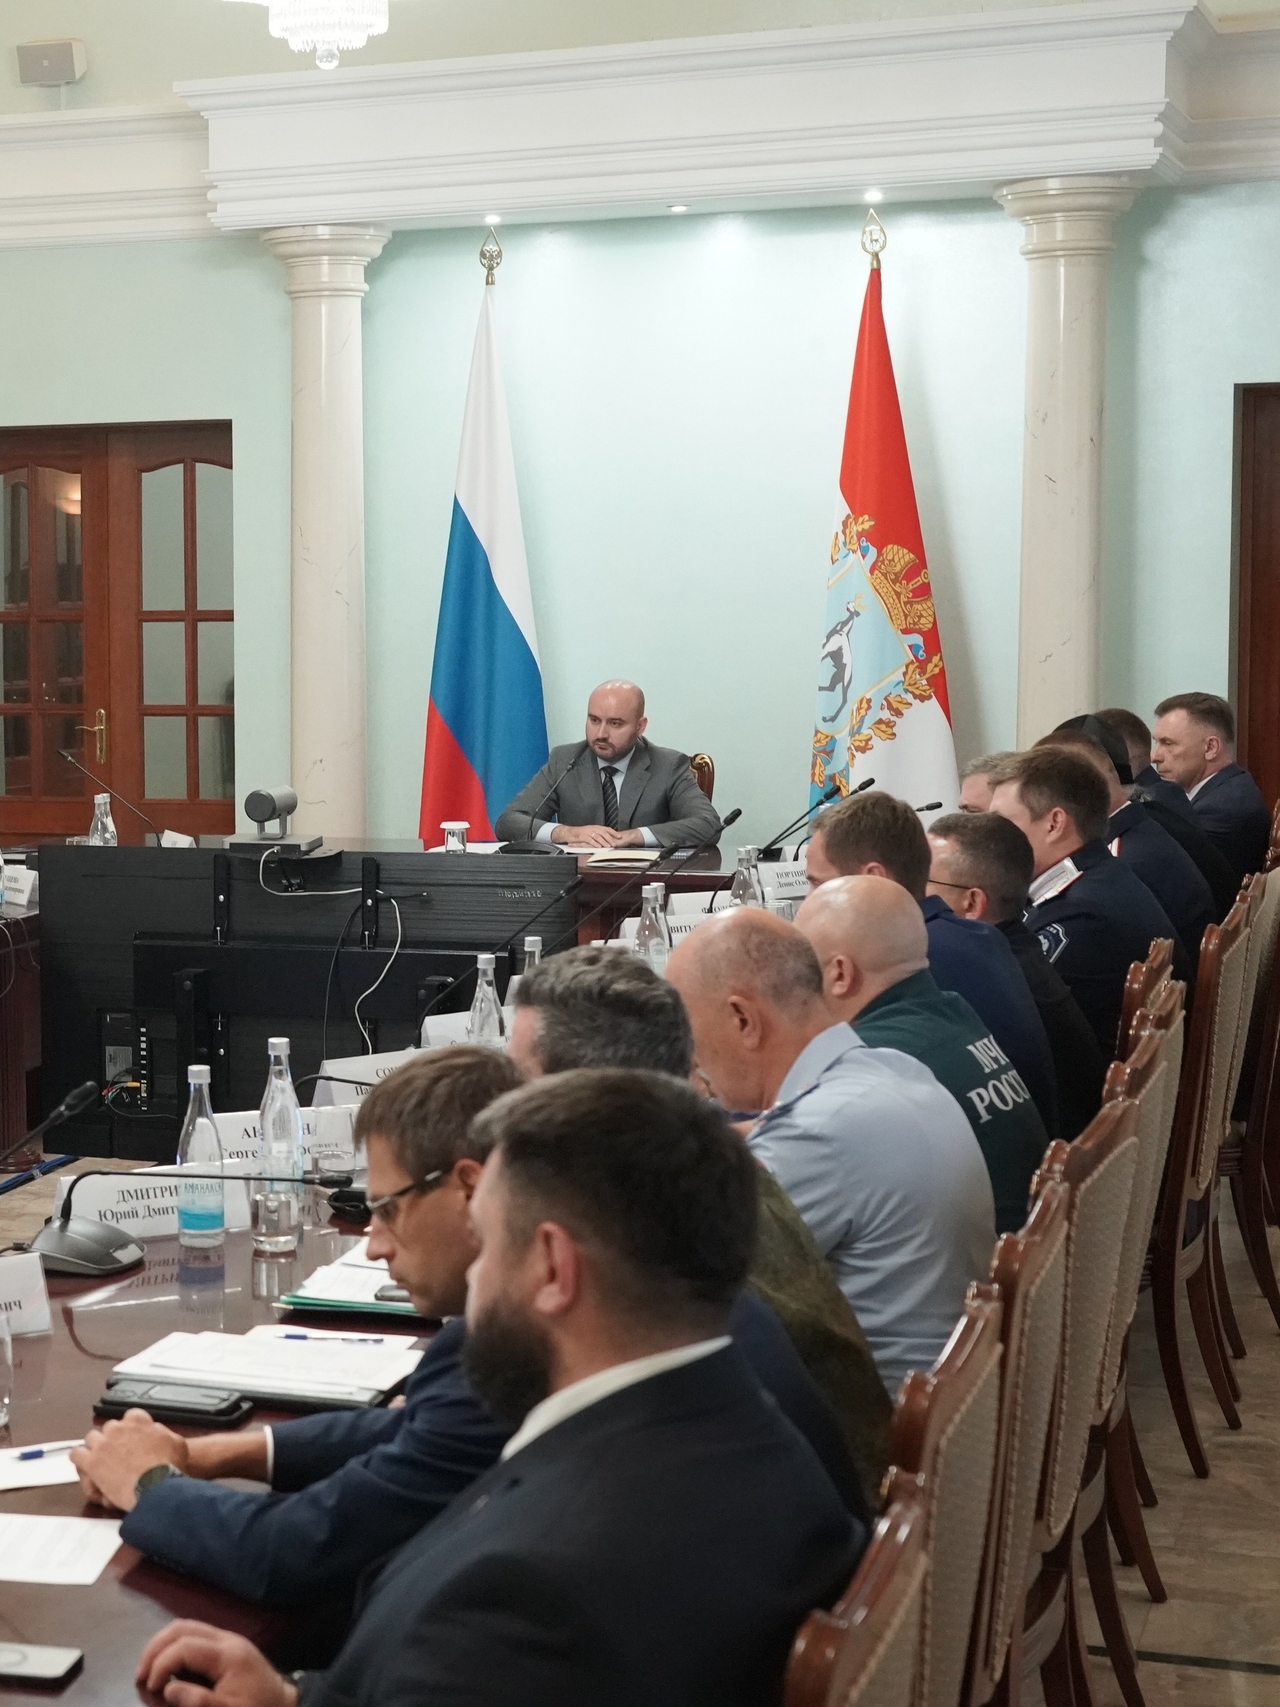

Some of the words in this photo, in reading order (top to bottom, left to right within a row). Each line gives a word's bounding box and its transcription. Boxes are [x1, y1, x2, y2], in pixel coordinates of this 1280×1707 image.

[966, 1068, 1032, 1123] РОСС
[116, 1184, 178, 1204] ДМИТРИ
[98, 1208, 139, 1224] Юрий
[142, 1205, 178, 1220] Дмит
